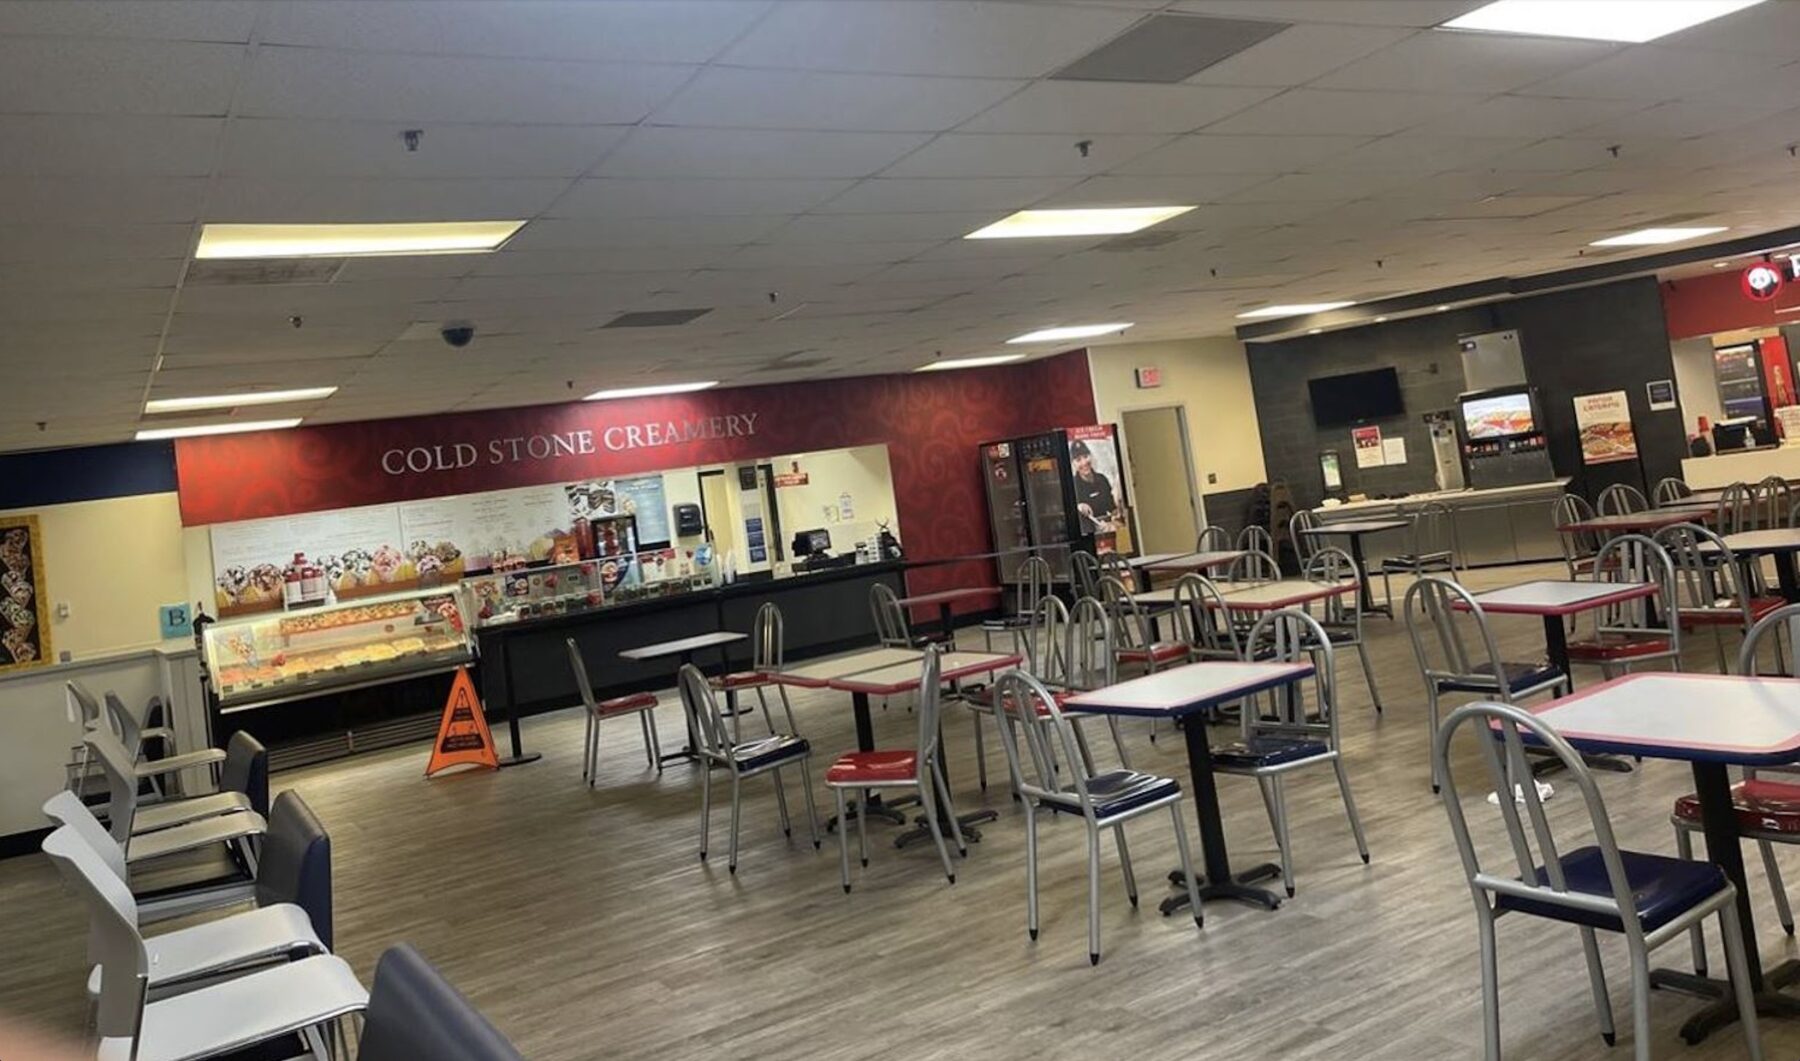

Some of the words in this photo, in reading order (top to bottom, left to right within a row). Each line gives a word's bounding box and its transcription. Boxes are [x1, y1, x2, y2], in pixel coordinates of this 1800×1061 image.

[382, 444, 478, 475] COLD
[489, 430, 596, 465] STONE
[604, 413, 759, 451] CREAMERY
[169, 609, 186, 627] B
